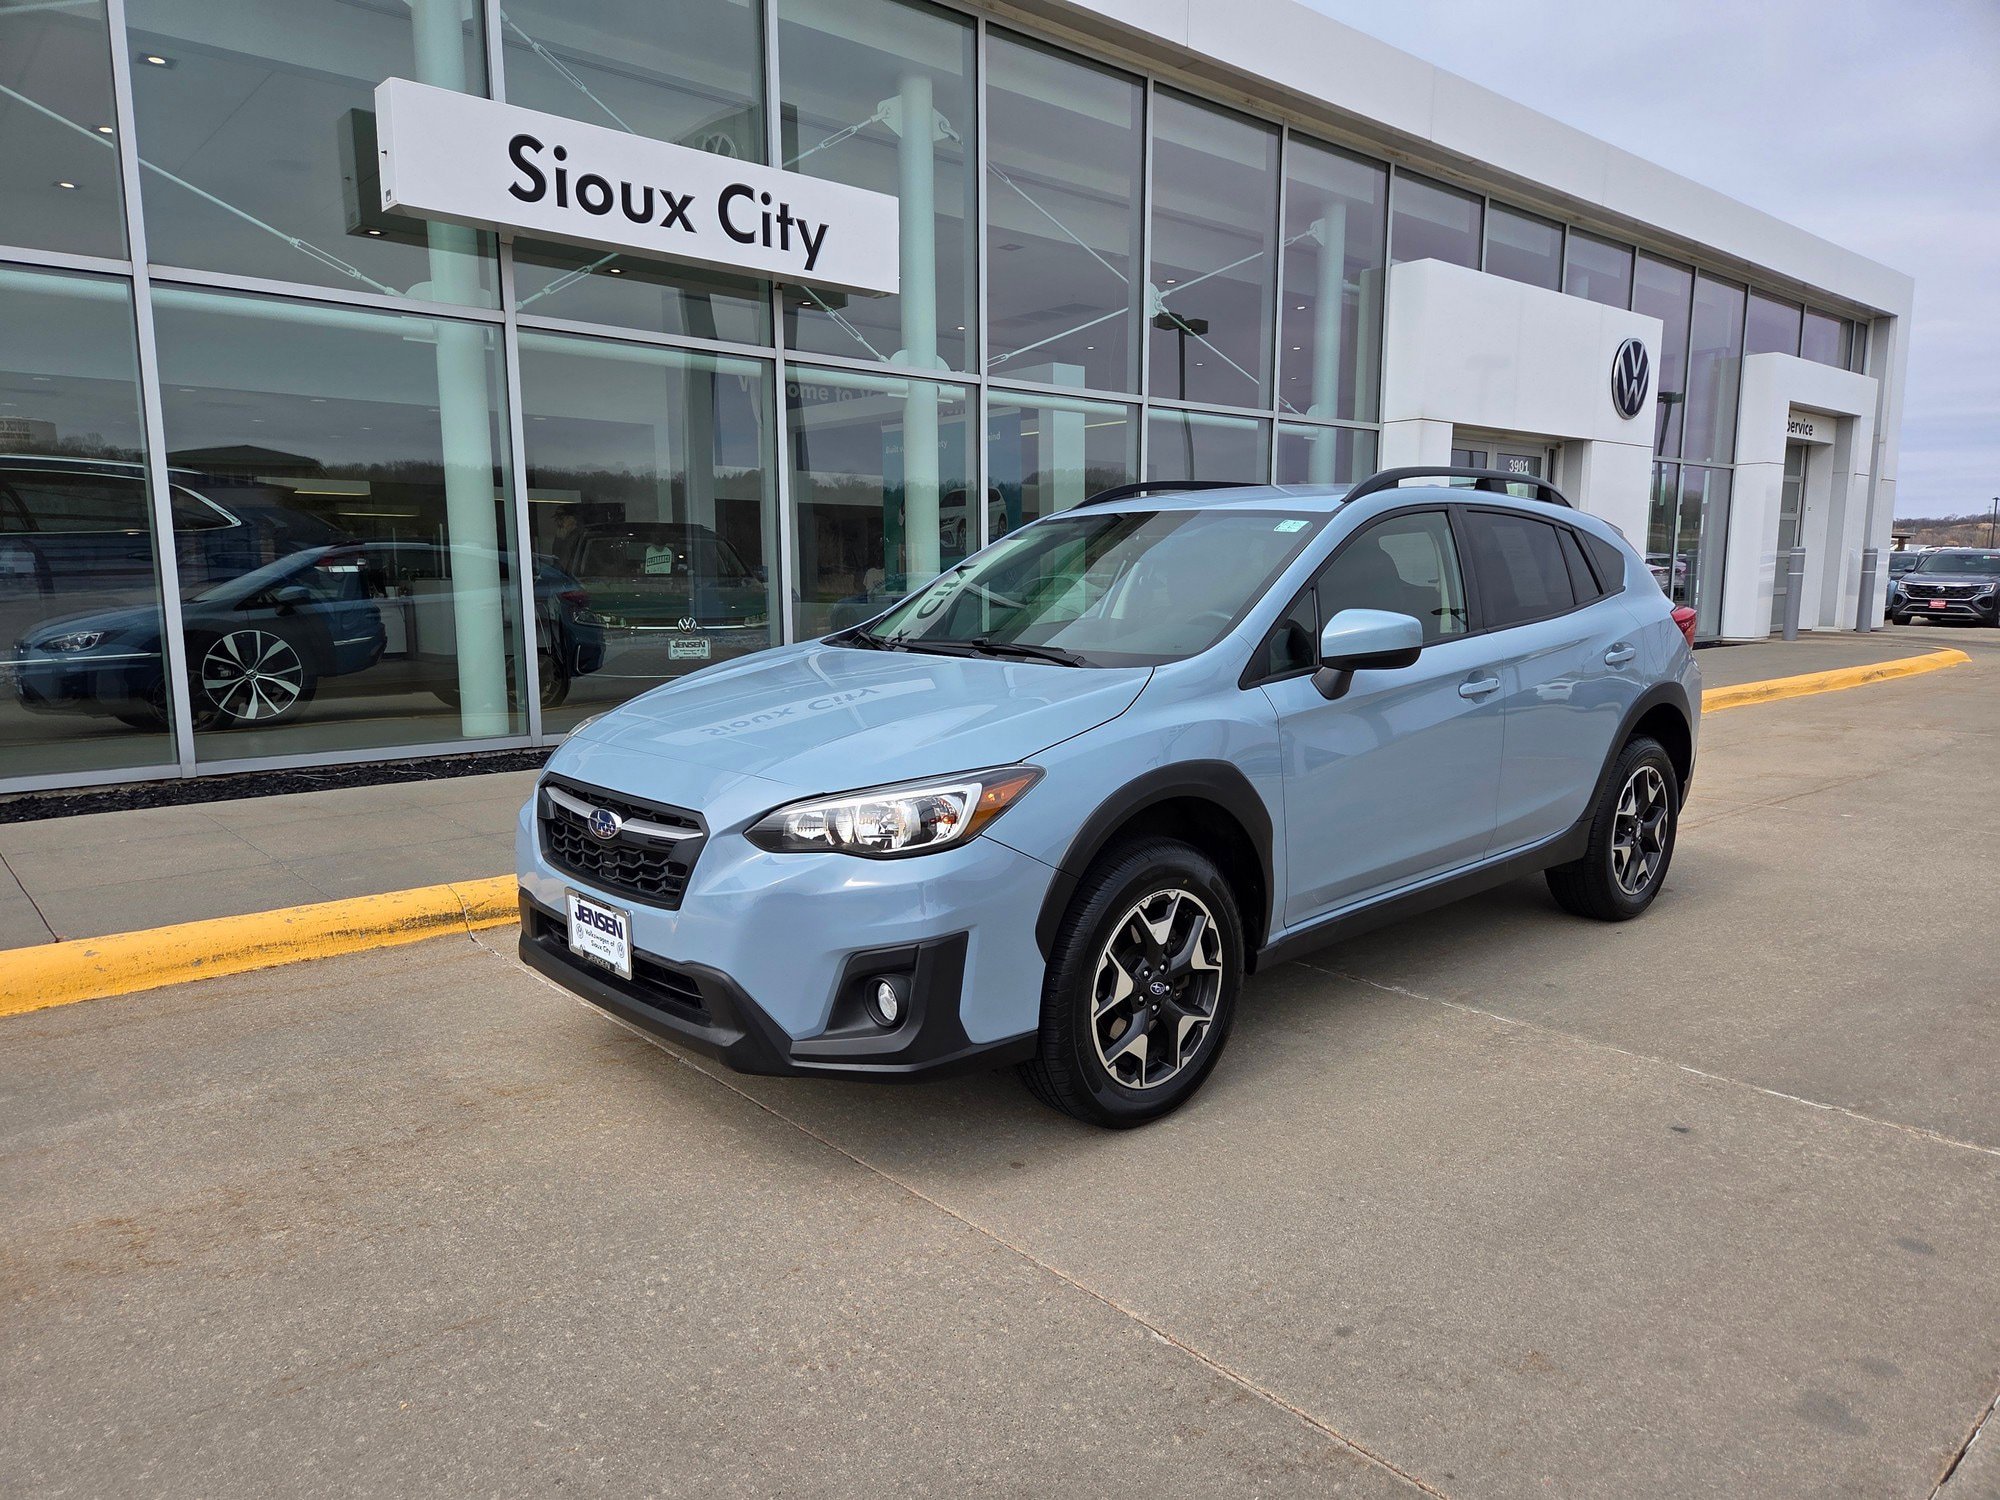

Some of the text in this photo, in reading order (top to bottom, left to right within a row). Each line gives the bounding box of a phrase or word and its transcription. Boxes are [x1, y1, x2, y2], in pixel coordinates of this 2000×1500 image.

[508, 133, 829, 271] Sioux City
[1509, 459, 1529, 472] 3901
[574, 904, 624, 940] JENSEN
